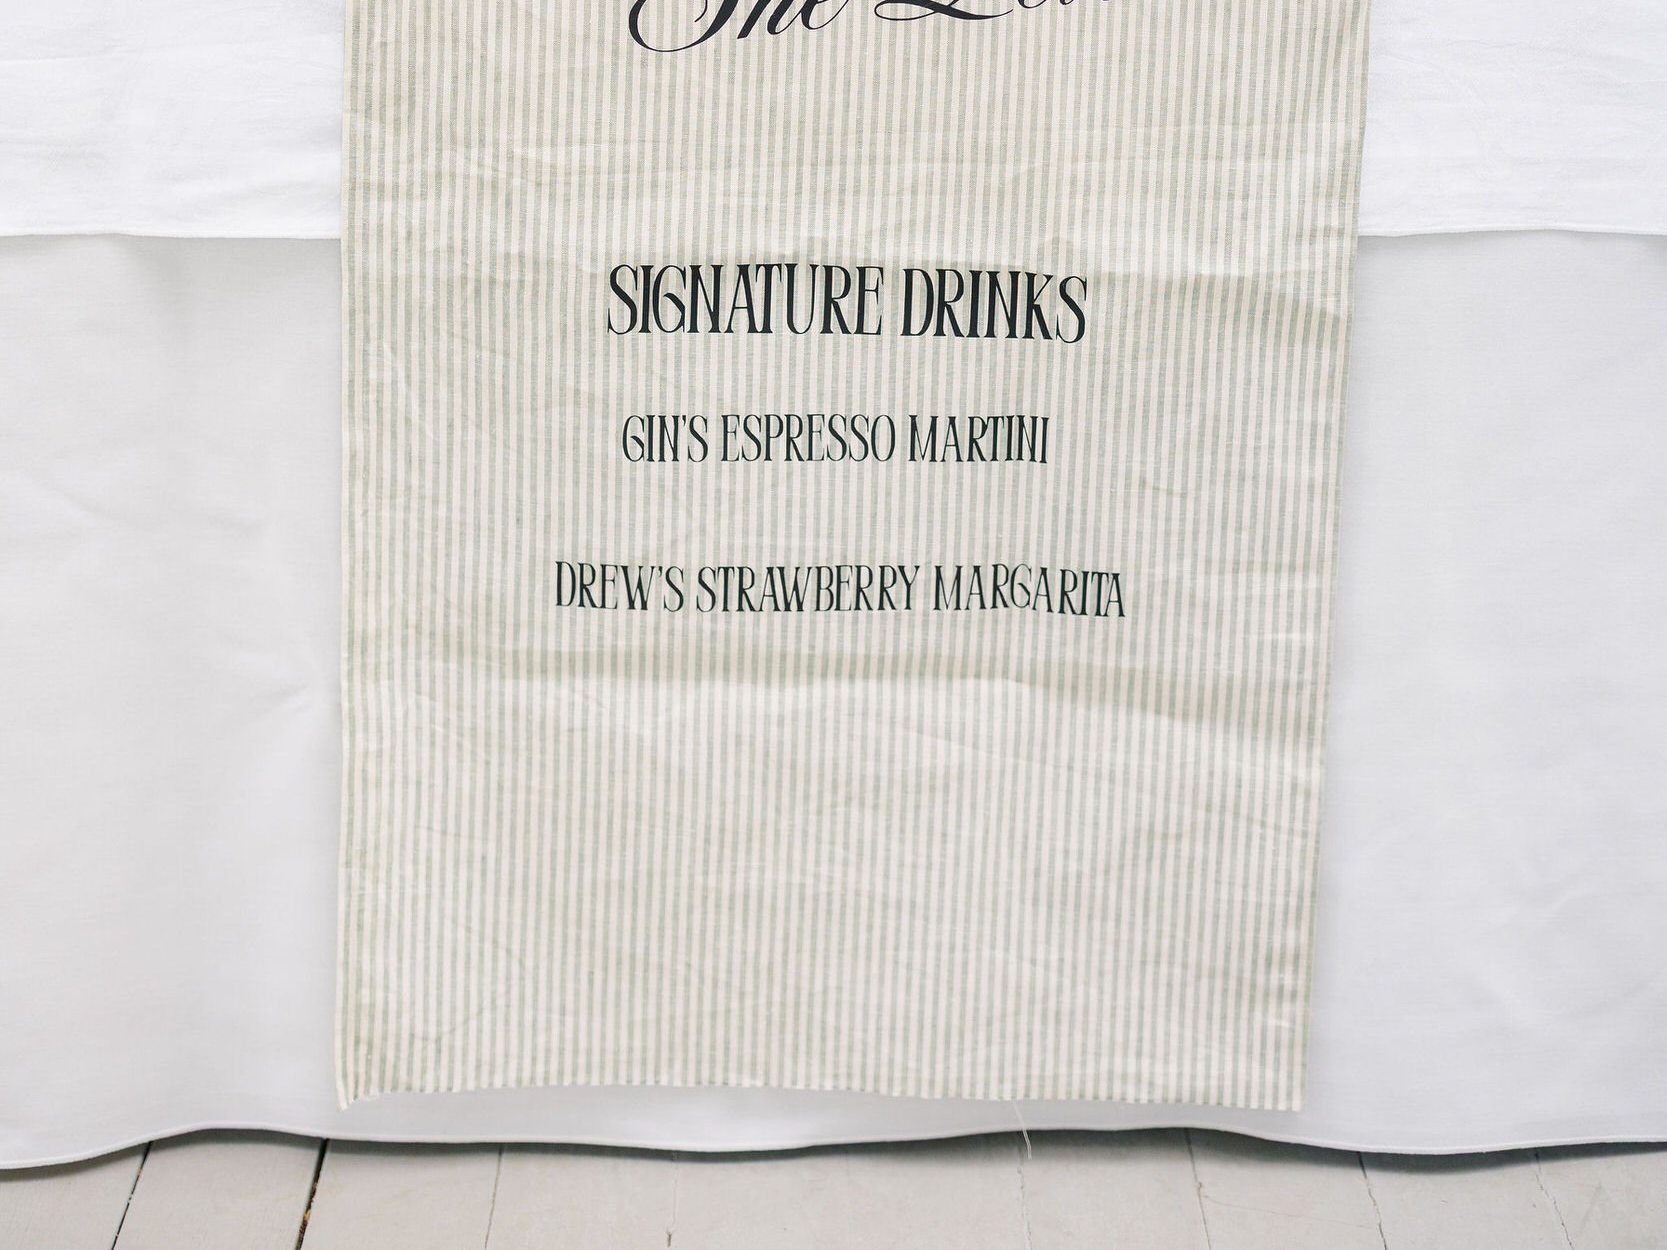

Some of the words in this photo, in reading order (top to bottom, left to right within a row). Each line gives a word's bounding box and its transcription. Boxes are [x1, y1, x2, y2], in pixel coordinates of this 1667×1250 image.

[607, 263, 884, 336] SIGNATURE
[900, 268, 1088, 344] DRINKS
[622, 414, 709, 463] GIN'S
[721, 413, 896, 462] ESPRESSO
[908, 414, 1050, 464] MARTINI
[555, 561, 684, 613] DREW'S
[696, 564, 921, 613] STRAWBERRY
[933, 563, 1126, 618] MARGARITA
